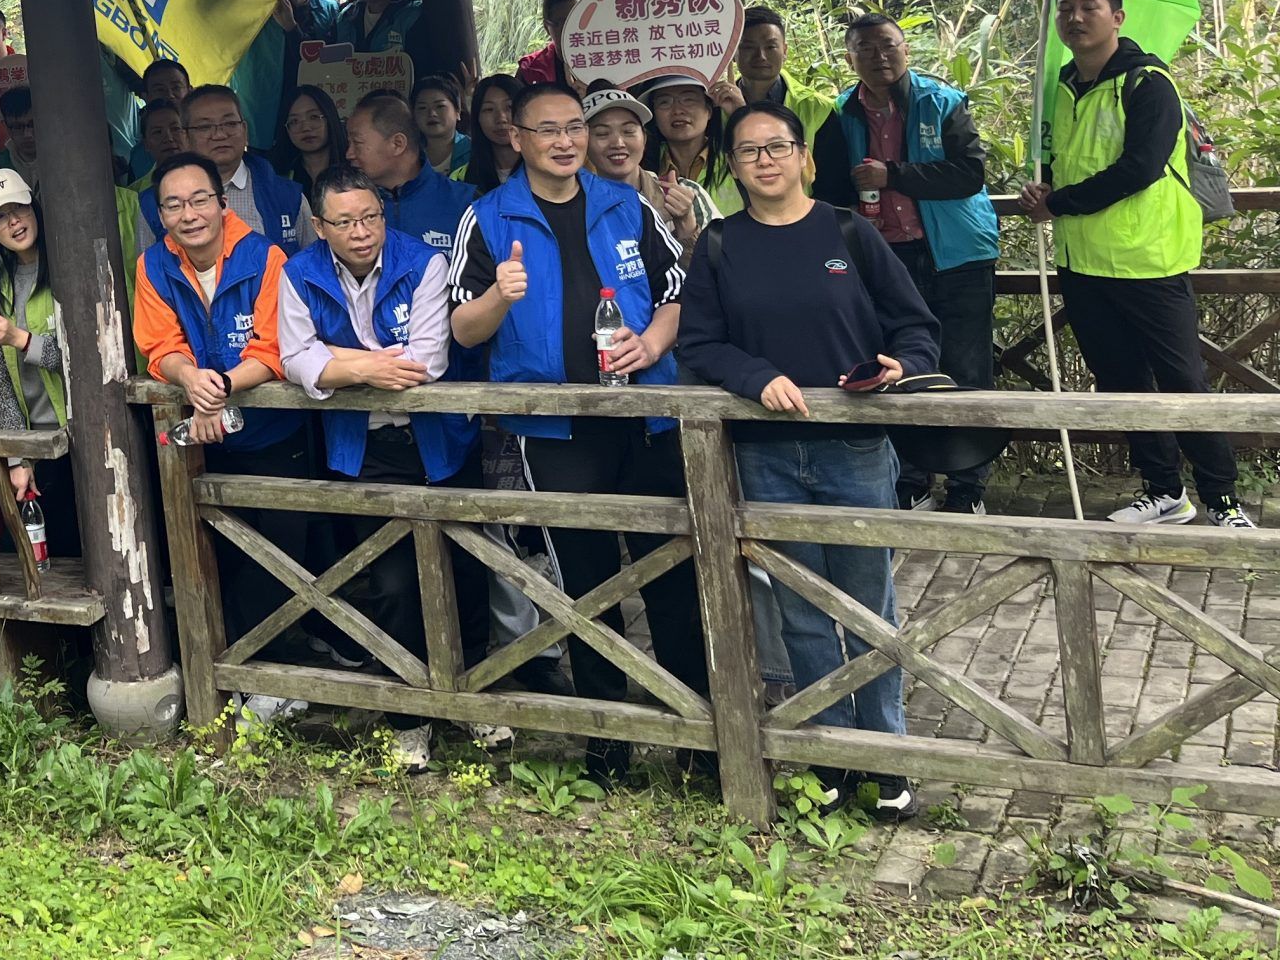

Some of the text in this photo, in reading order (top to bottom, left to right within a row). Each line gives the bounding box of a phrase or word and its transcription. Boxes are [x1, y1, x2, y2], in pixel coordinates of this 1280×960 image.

[569, 19, 722, 49] 亲近自然 放飞心灵
[345, 54, 407, 78] 飞虎队
[571, 41, 724, 70] 追逐梦想 不忘初心
